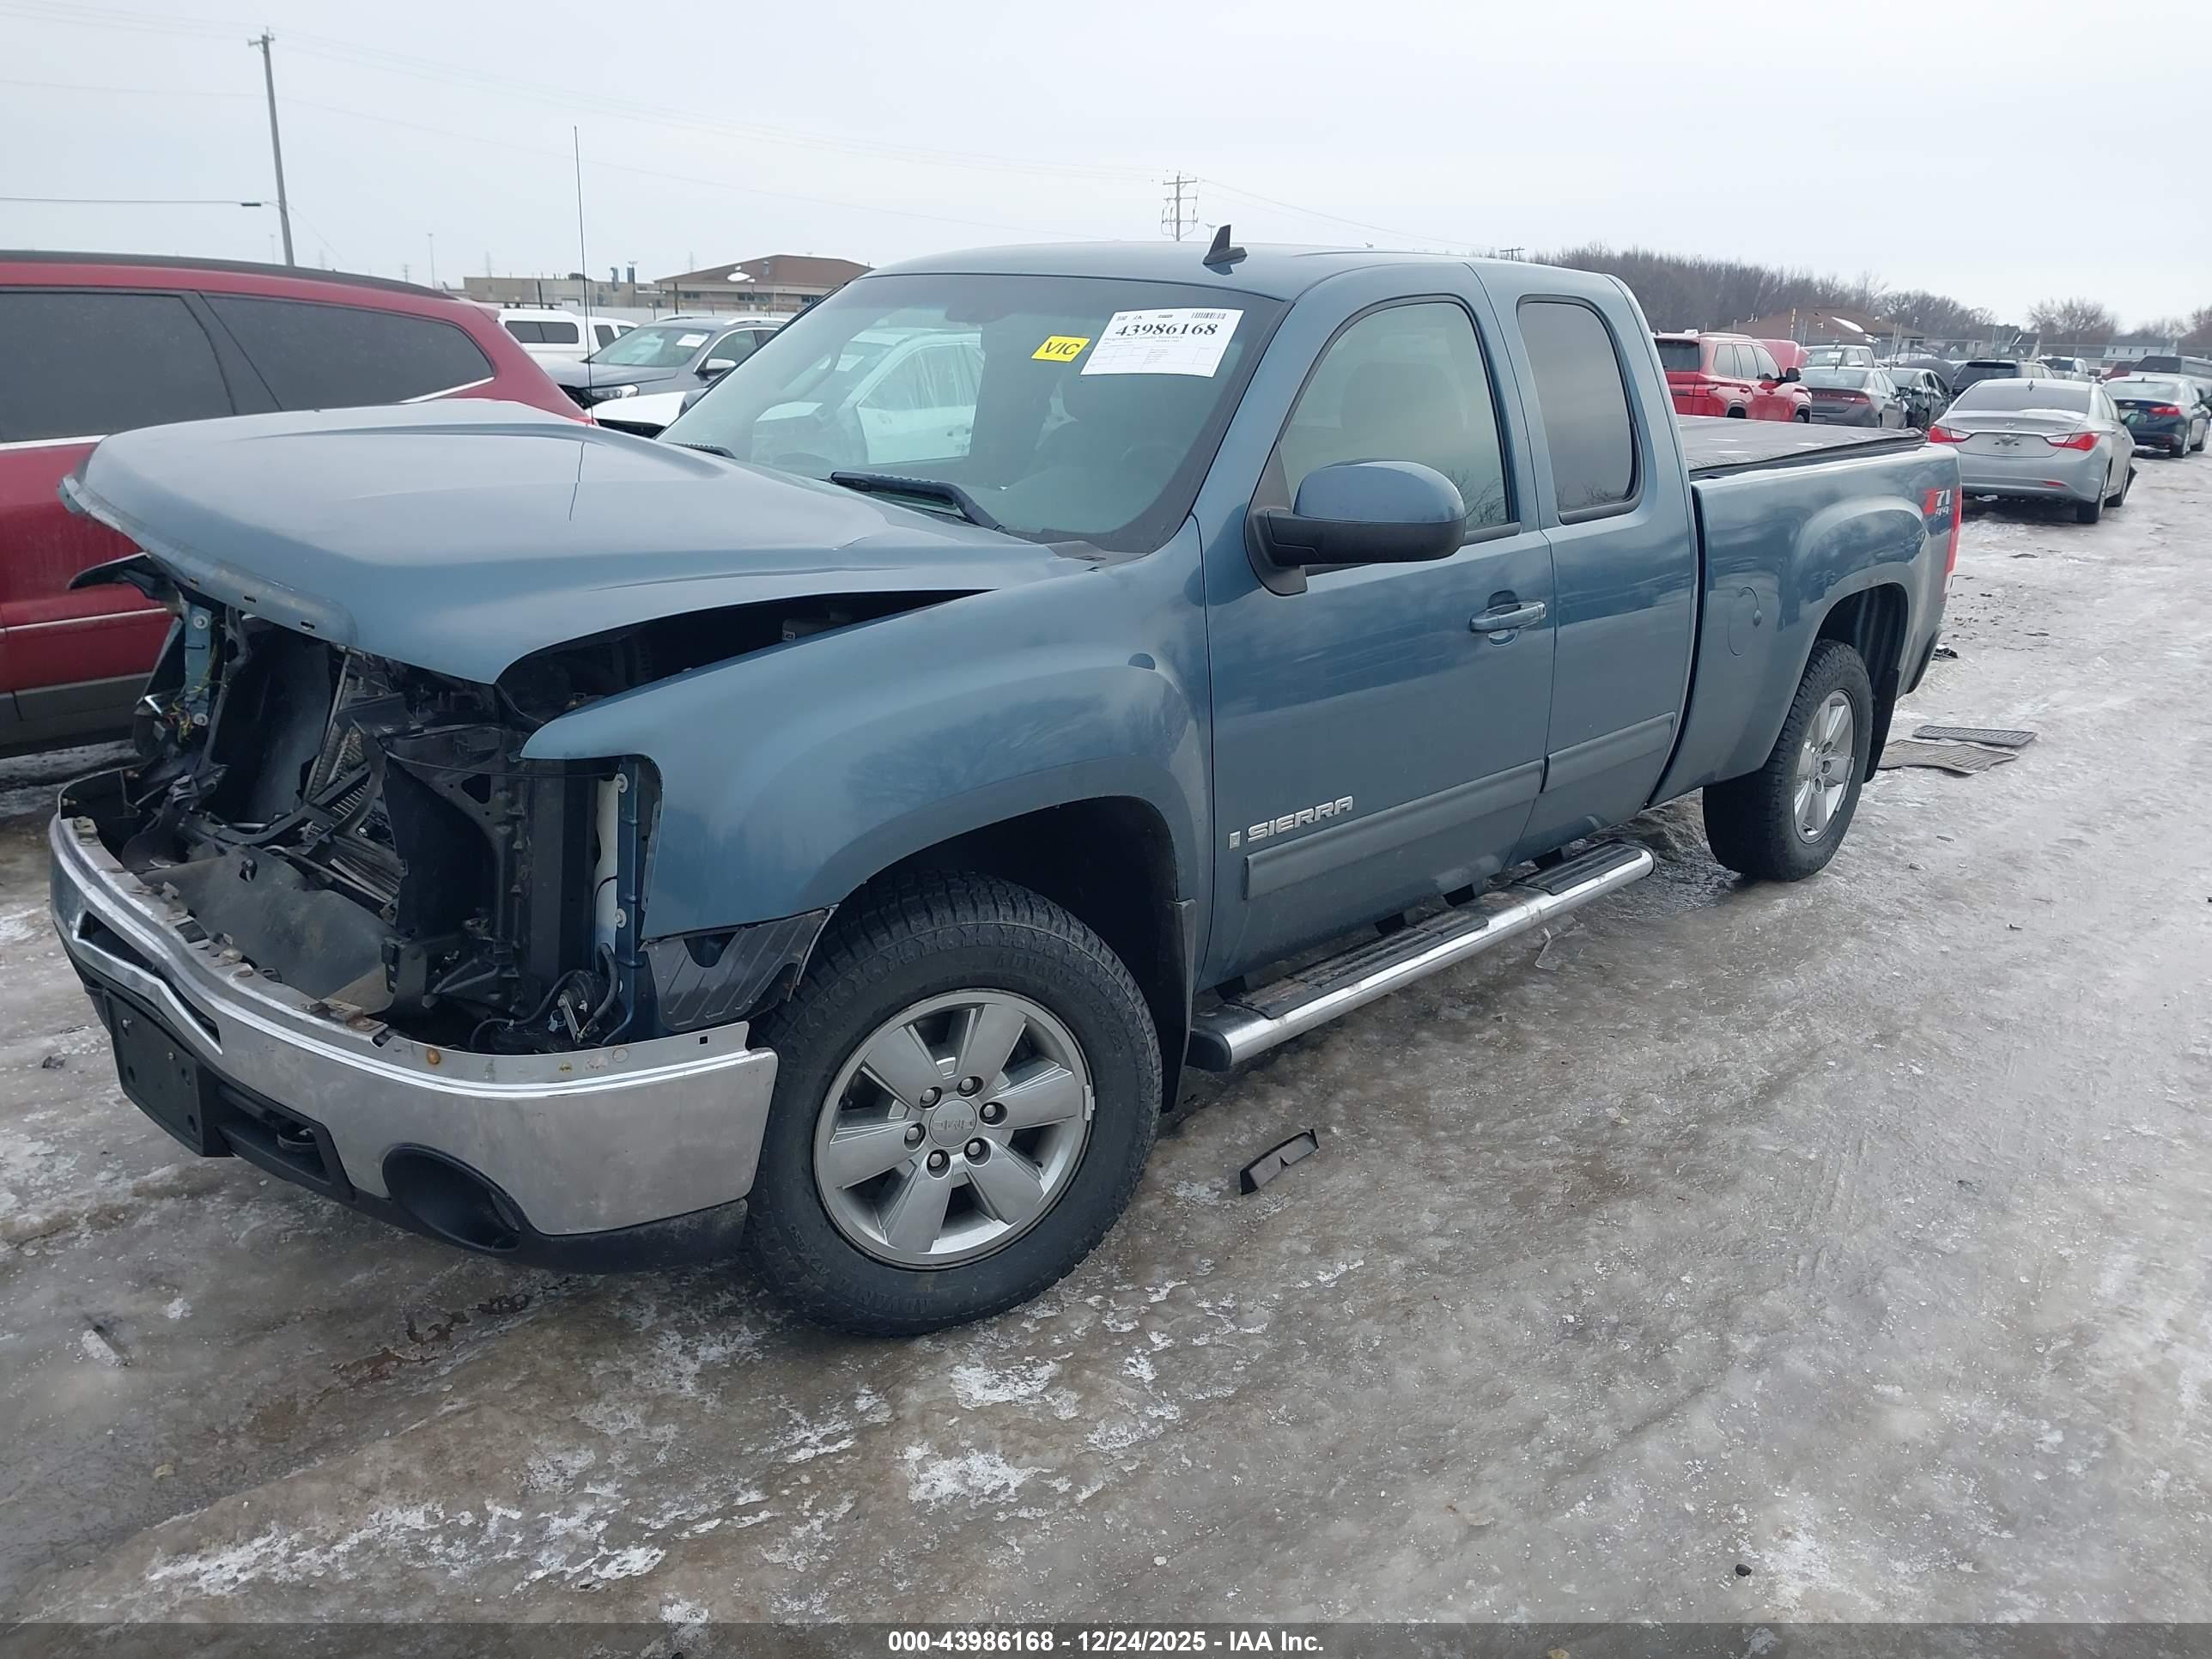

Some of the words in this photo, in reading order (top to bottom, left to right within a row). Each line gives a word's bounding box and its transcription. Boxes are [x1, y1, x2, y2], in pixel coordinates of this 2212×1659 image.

[1115, 323, 1218, 337] 43986168
[1043, 341, 1081, 356] VIC
[1247, 795, 1353, 843] SIERRA
